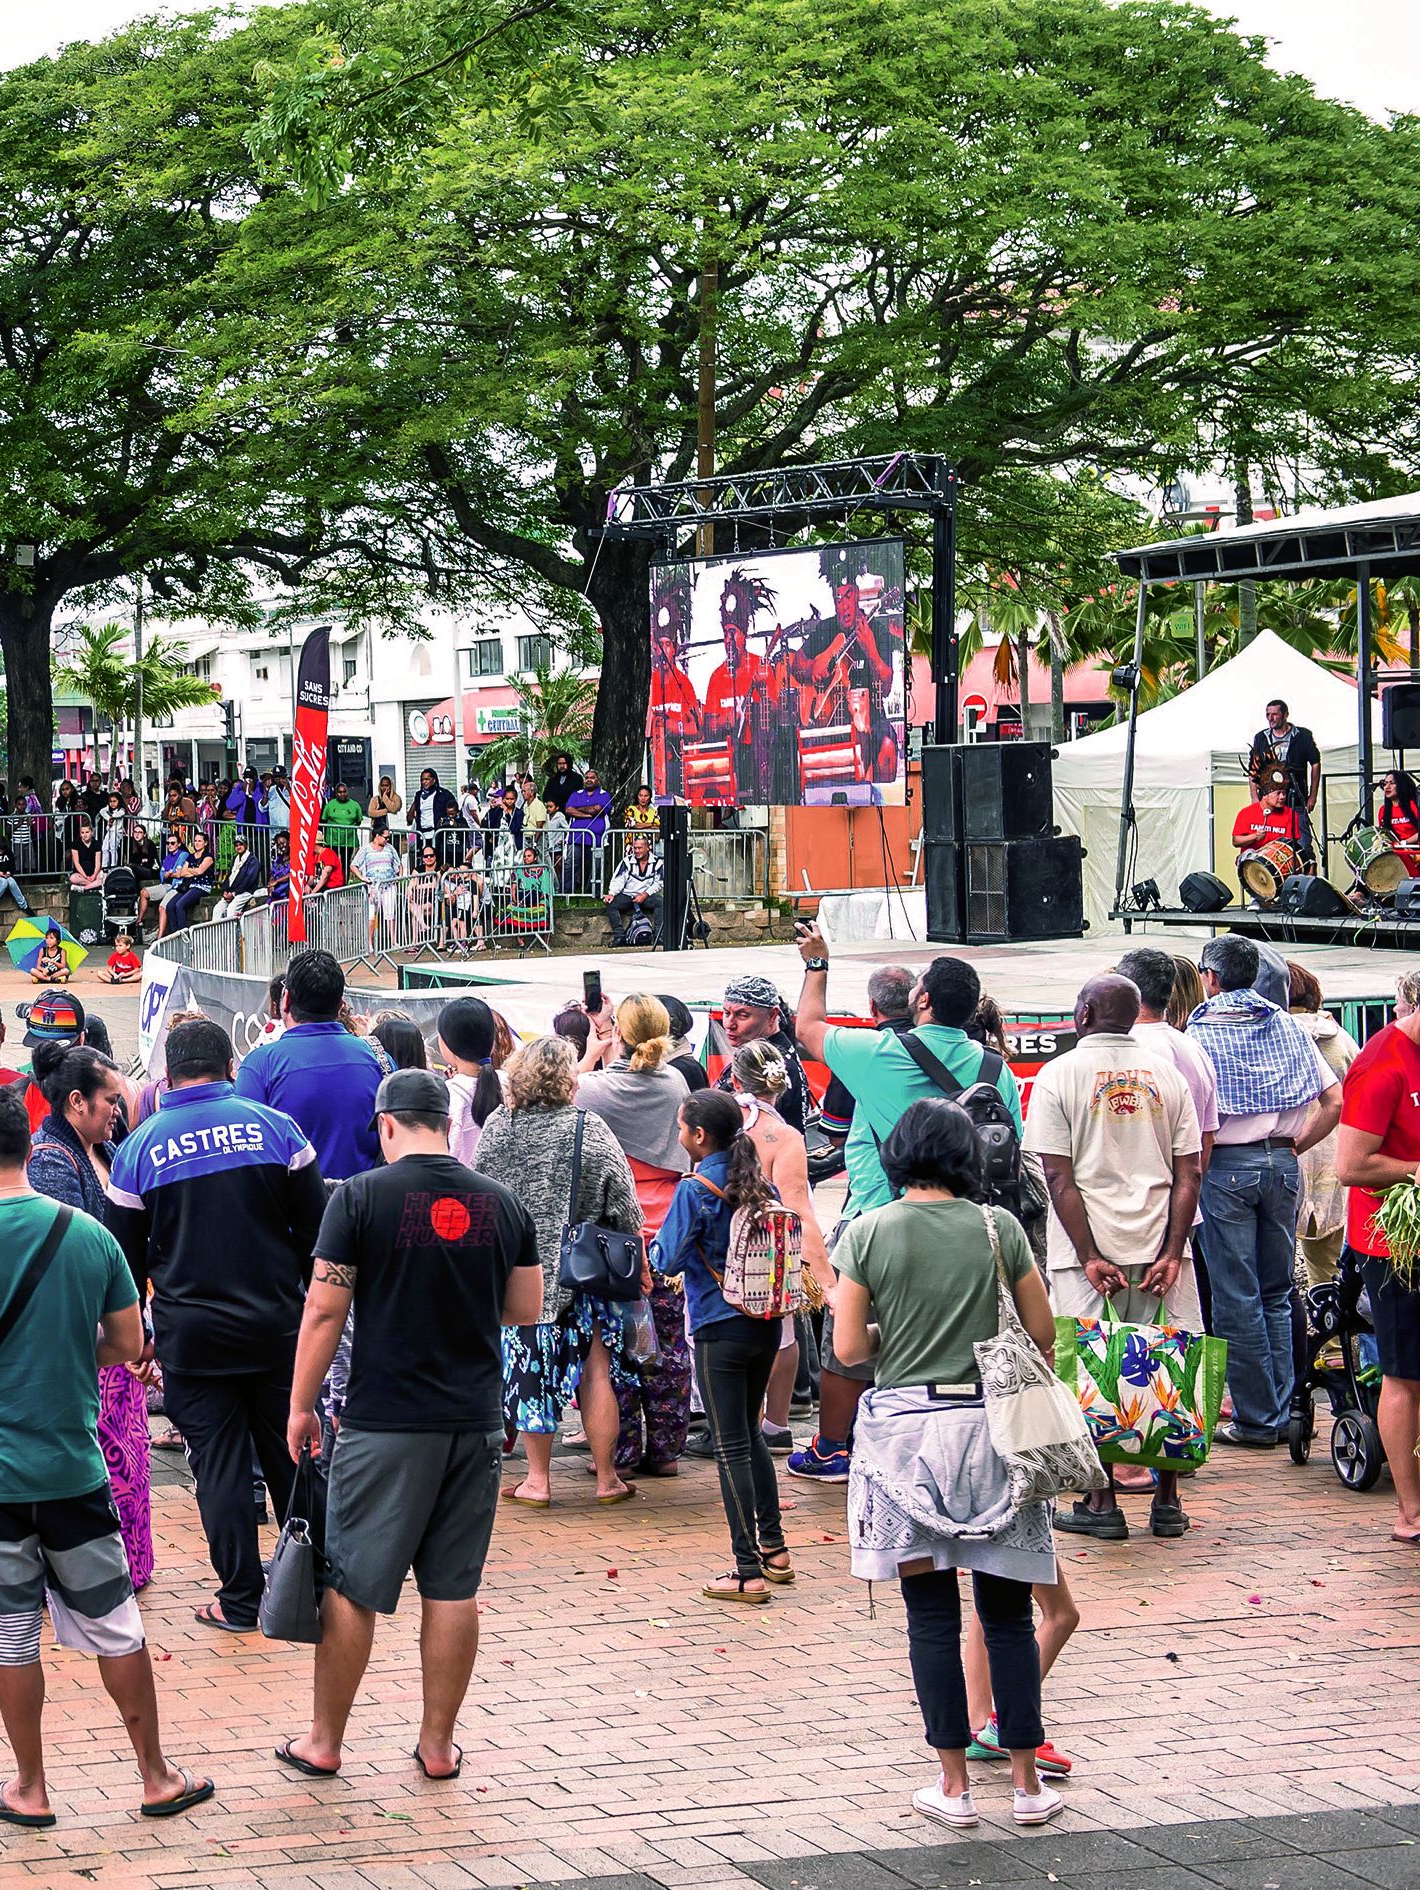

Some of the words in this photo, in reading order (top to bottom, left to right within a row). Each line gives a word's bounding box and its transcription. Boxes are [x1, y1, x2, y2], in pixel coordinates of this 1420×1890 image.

[304, 680, 324, 694] SANS
[299, 690, 330, 706] SUCRES
[1005, 1033, 1058, 1054] RES
[1090, 1069, 1163, 1109] ALOHA
[149, 1123, 264, 1168] CASTRES
[222, 1142, 265, 1156] OLYMPIQUE
